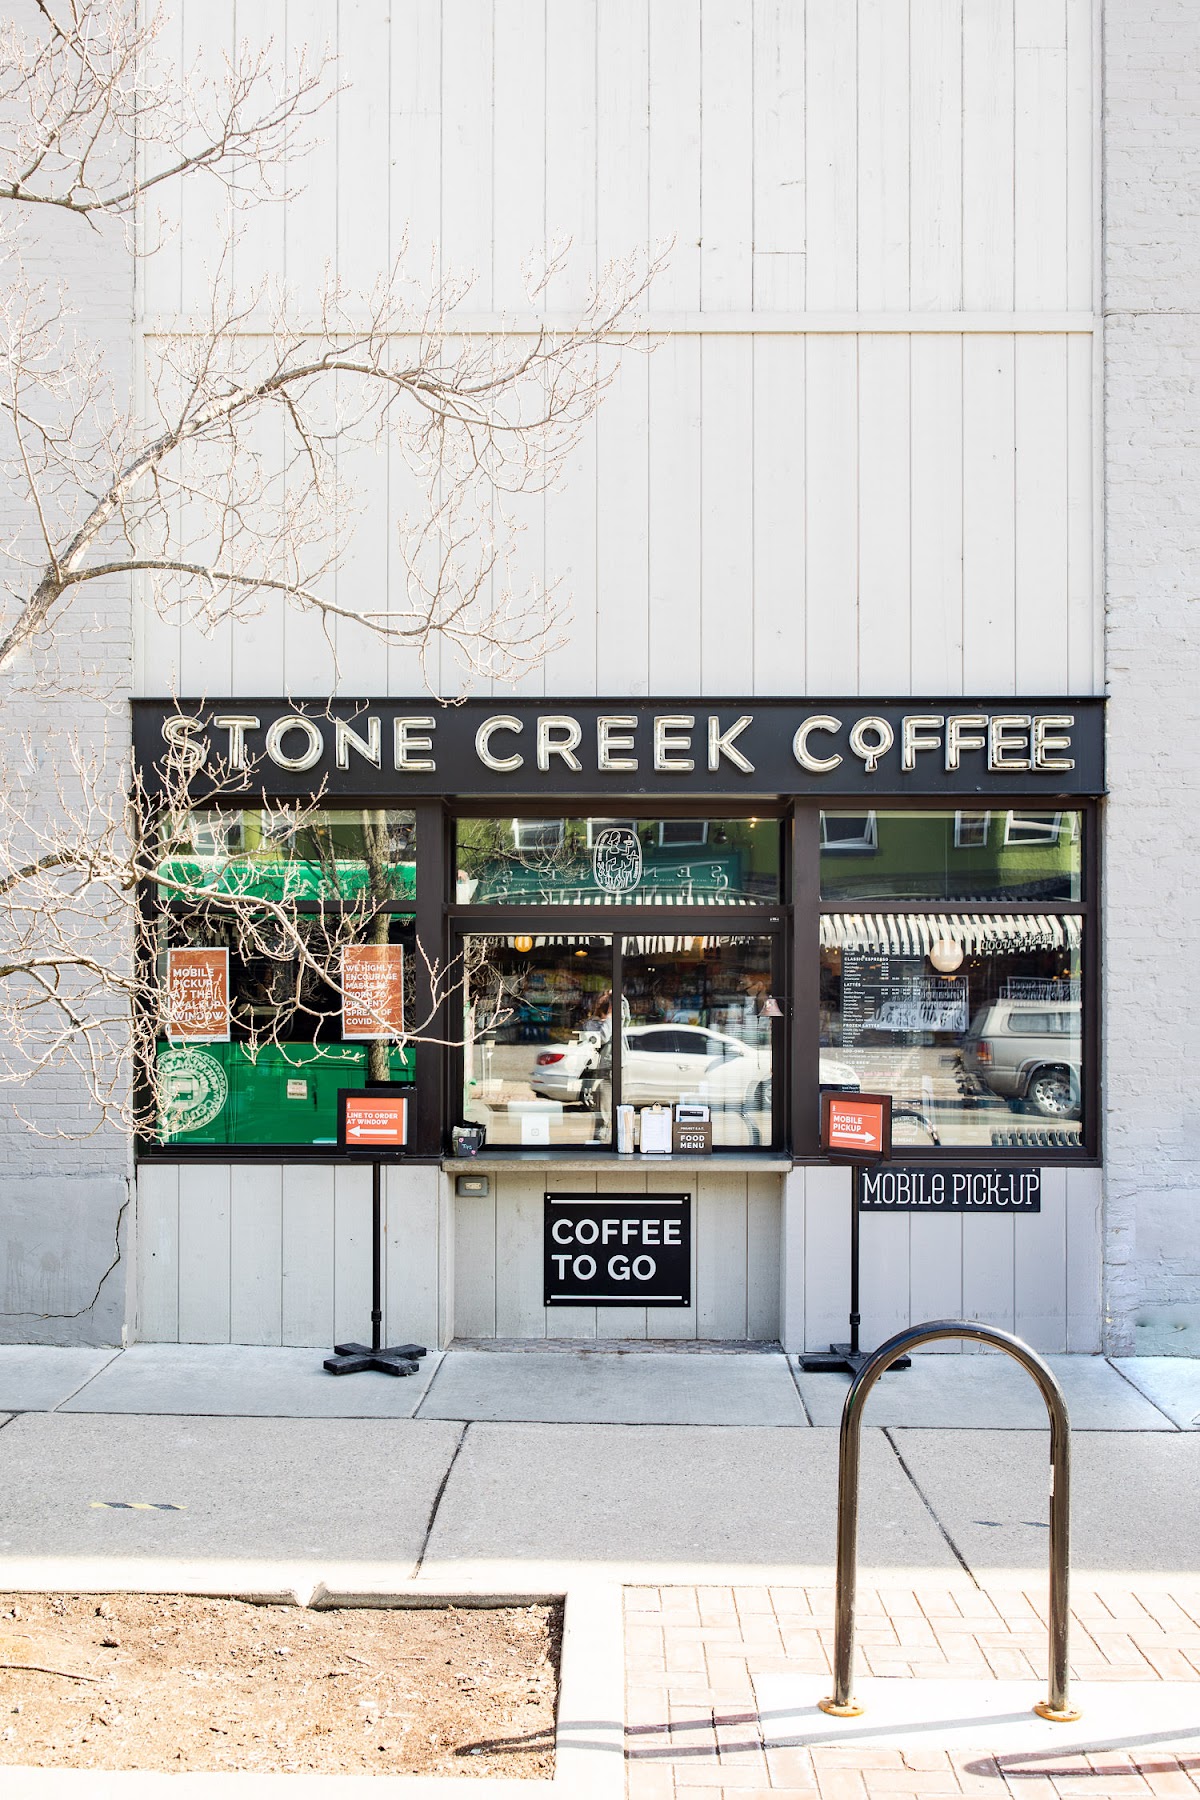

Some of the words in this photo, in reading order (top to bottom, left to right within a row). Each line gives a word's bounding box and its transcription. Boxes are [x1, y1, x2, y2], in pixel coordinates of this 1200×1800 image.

[161, 714, 436, 772] STONE
[475, 714, 755, 773] CREEK
[792, 714, 1075, 773] COFFEE
[173, 968, 214, 977] MOBILE
[173, 979, 213, 988] PICKUP
[174, 1011, 224, 1020] WINDOW
[381, 1008, 393, 1016] OF
[833, 1115, 863, 1124] MOBILE
[832, 1122, 862, 1132] PICKUP
[952, 1173, 1040, 1206] PICK-UP
[551, 1218, 682, 1245] COFFEE
[551, 1254, 597, 1281] TO
[607, 1254, 656, 1281] GO
